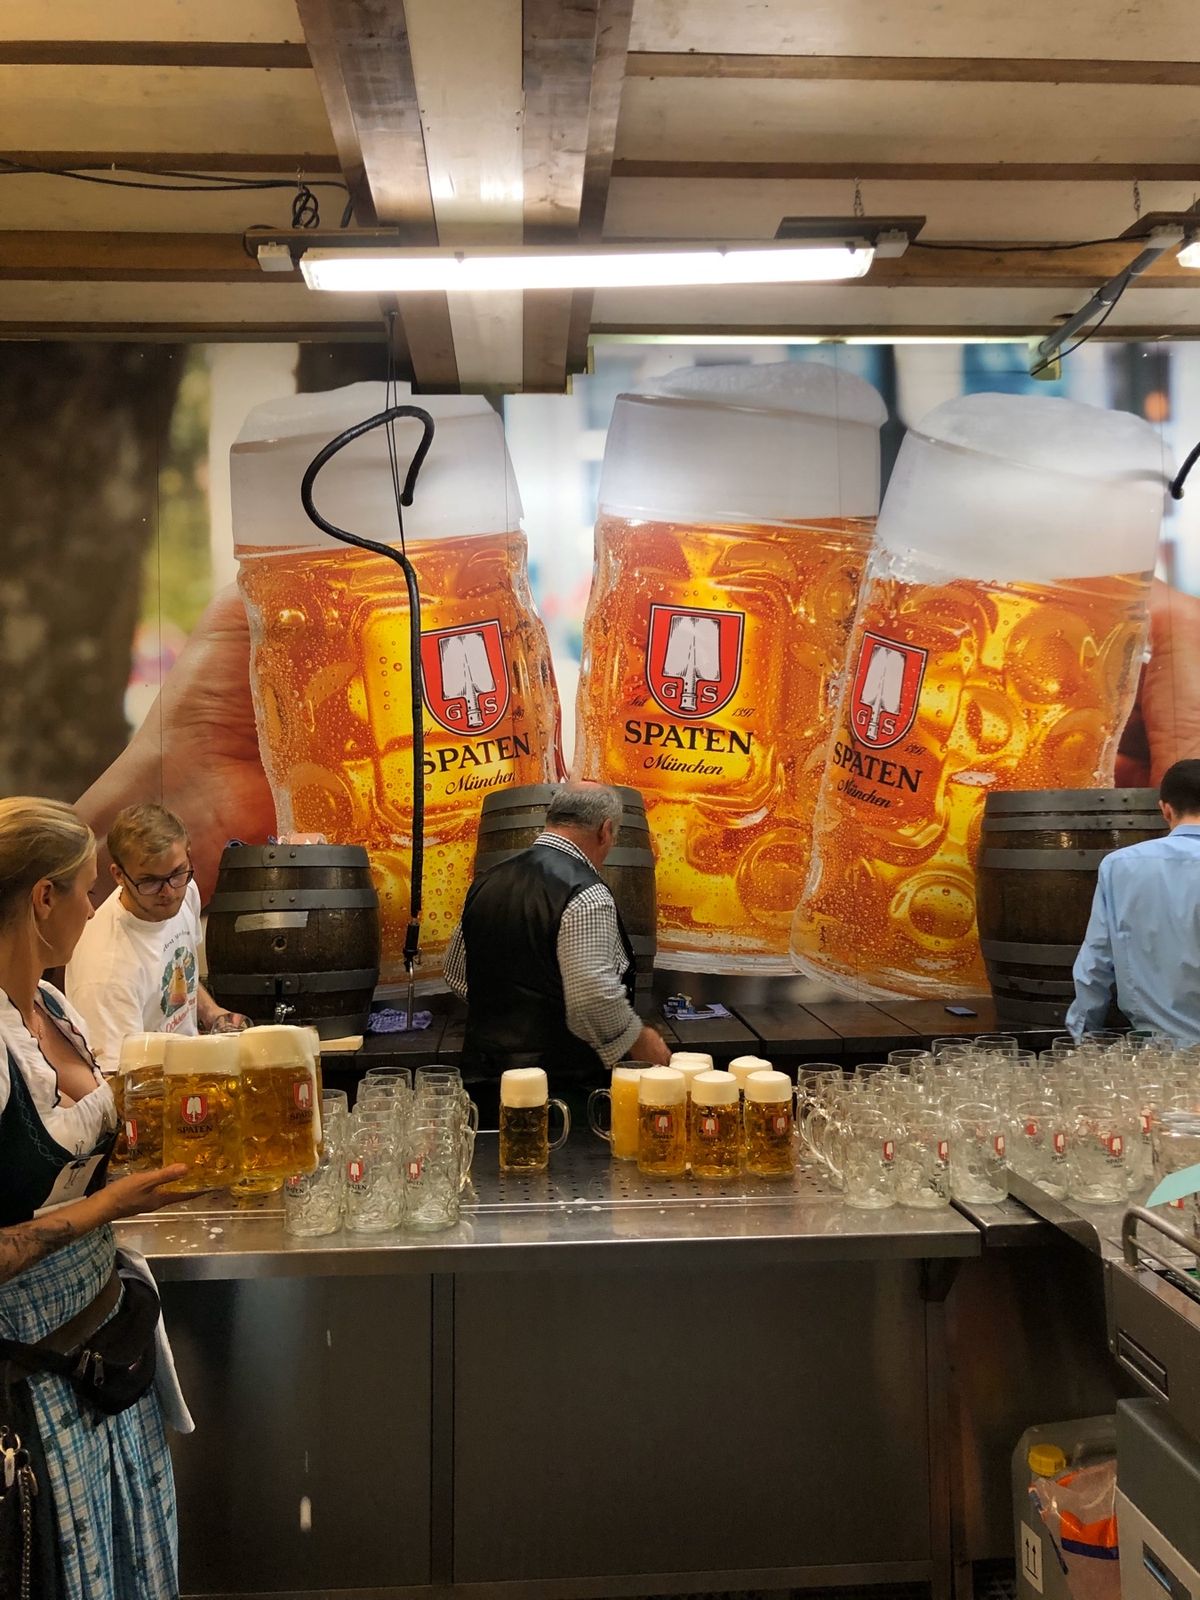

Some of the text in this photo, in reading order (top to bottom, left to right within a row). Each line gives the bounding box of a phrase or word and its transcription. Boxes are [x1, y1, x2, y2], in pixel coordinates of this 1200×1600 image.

[661, 682, 719, 704] G S
[445, 703, 463, 720] G
[483, 697, 499, 716] S
[856, 709, 896, 735] G S
[624, 719, 753, 755] SPATEN
[423, 732, 531, 776] SPATEN
[642, 753, 725, 776] München
[833, 741, 923, 792] SPATEN
[445, 769, 517, 796] München
[837, 778, 891, 808] München
